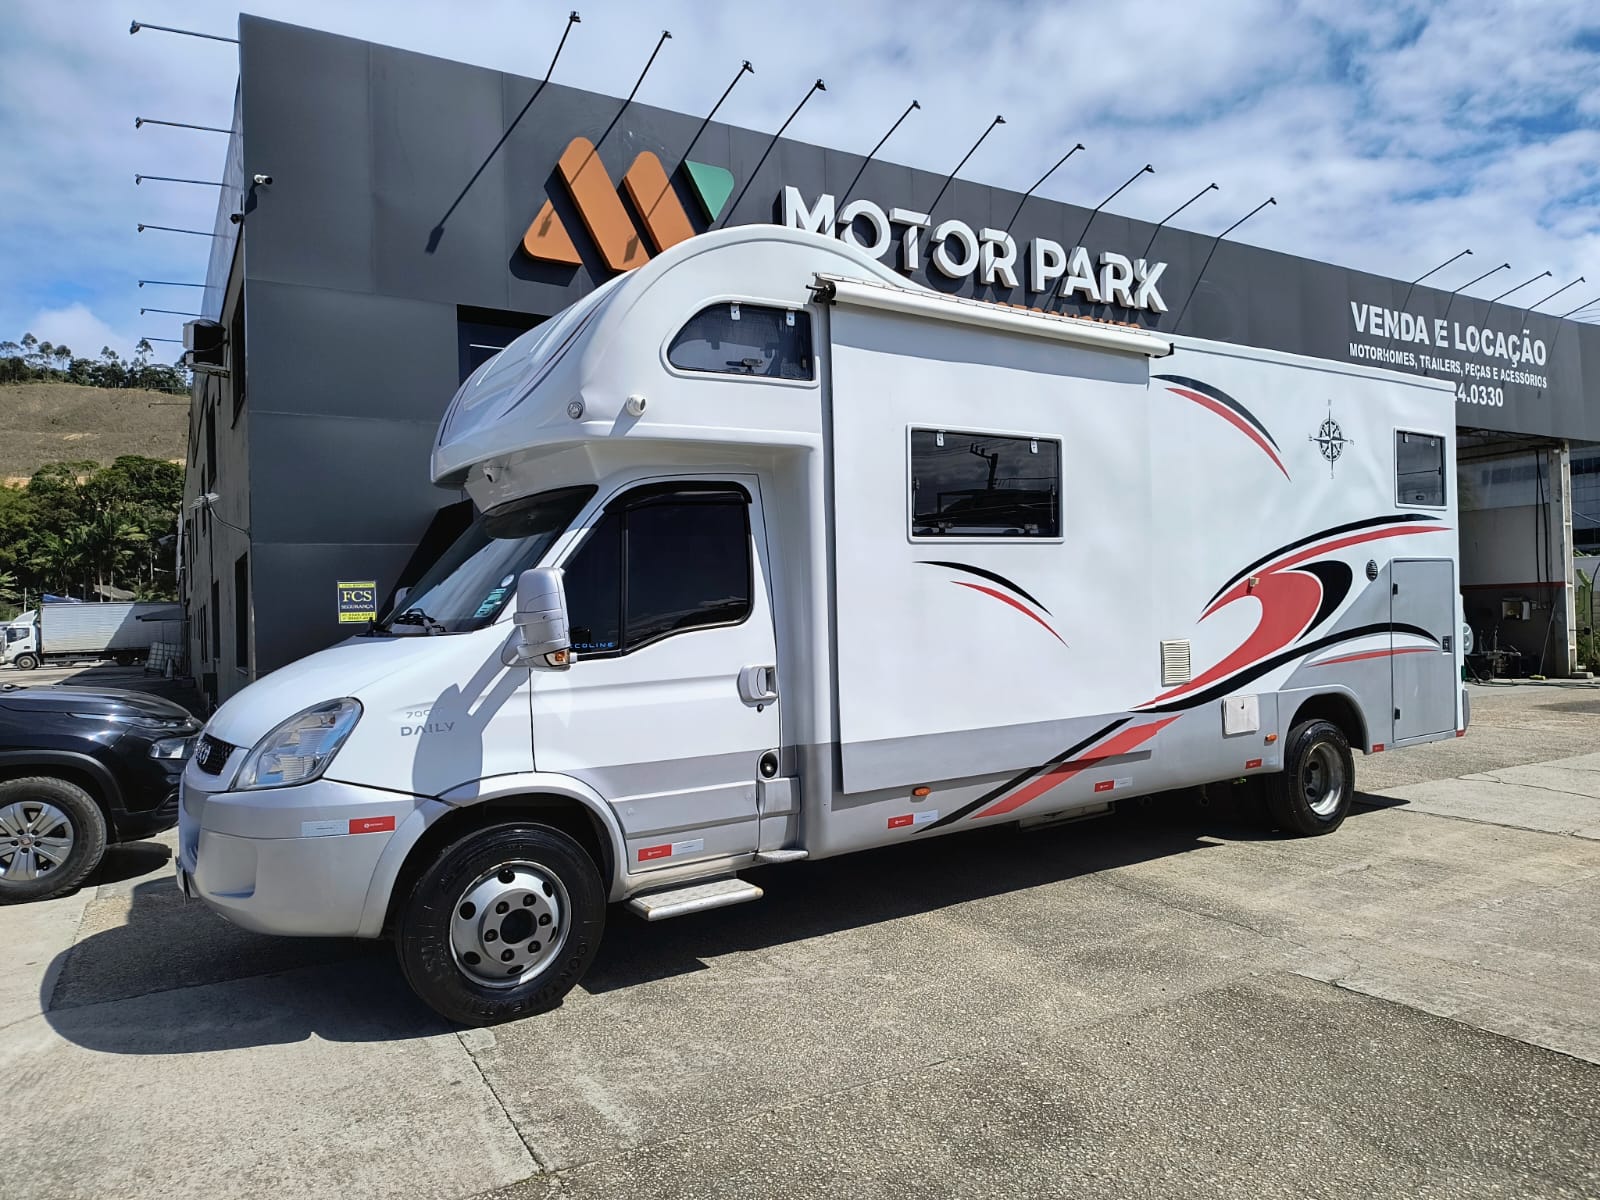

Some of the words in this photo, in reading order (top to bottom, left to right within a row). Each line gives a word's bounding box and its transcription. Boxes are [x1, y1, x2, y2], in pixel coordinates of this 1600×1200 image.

[784, 185, 1019, 288] MOTOR
[1030, 237, 1169, 313] PARK
[1350, 301, 1430, 345] VENDA
[1434, 318, 1449, 348] E
[1454, 322, 1547, 368] LOCAÇÃO
[1349, 343, 1418, 368] MOTORHOMES,
[1419, 354, 1464, 377] TRAILERS,
[1465, 362, 1491, 380] PEÇAS
[1493, 367, 1499, 380] E
[1500, 369, 1548, 389] ACESSÓRIOS
[1454, 382, 1504, 407] 4.0330
[342, 590, 372, 602] FCS
[400, 721, 455, 736] DAILY
